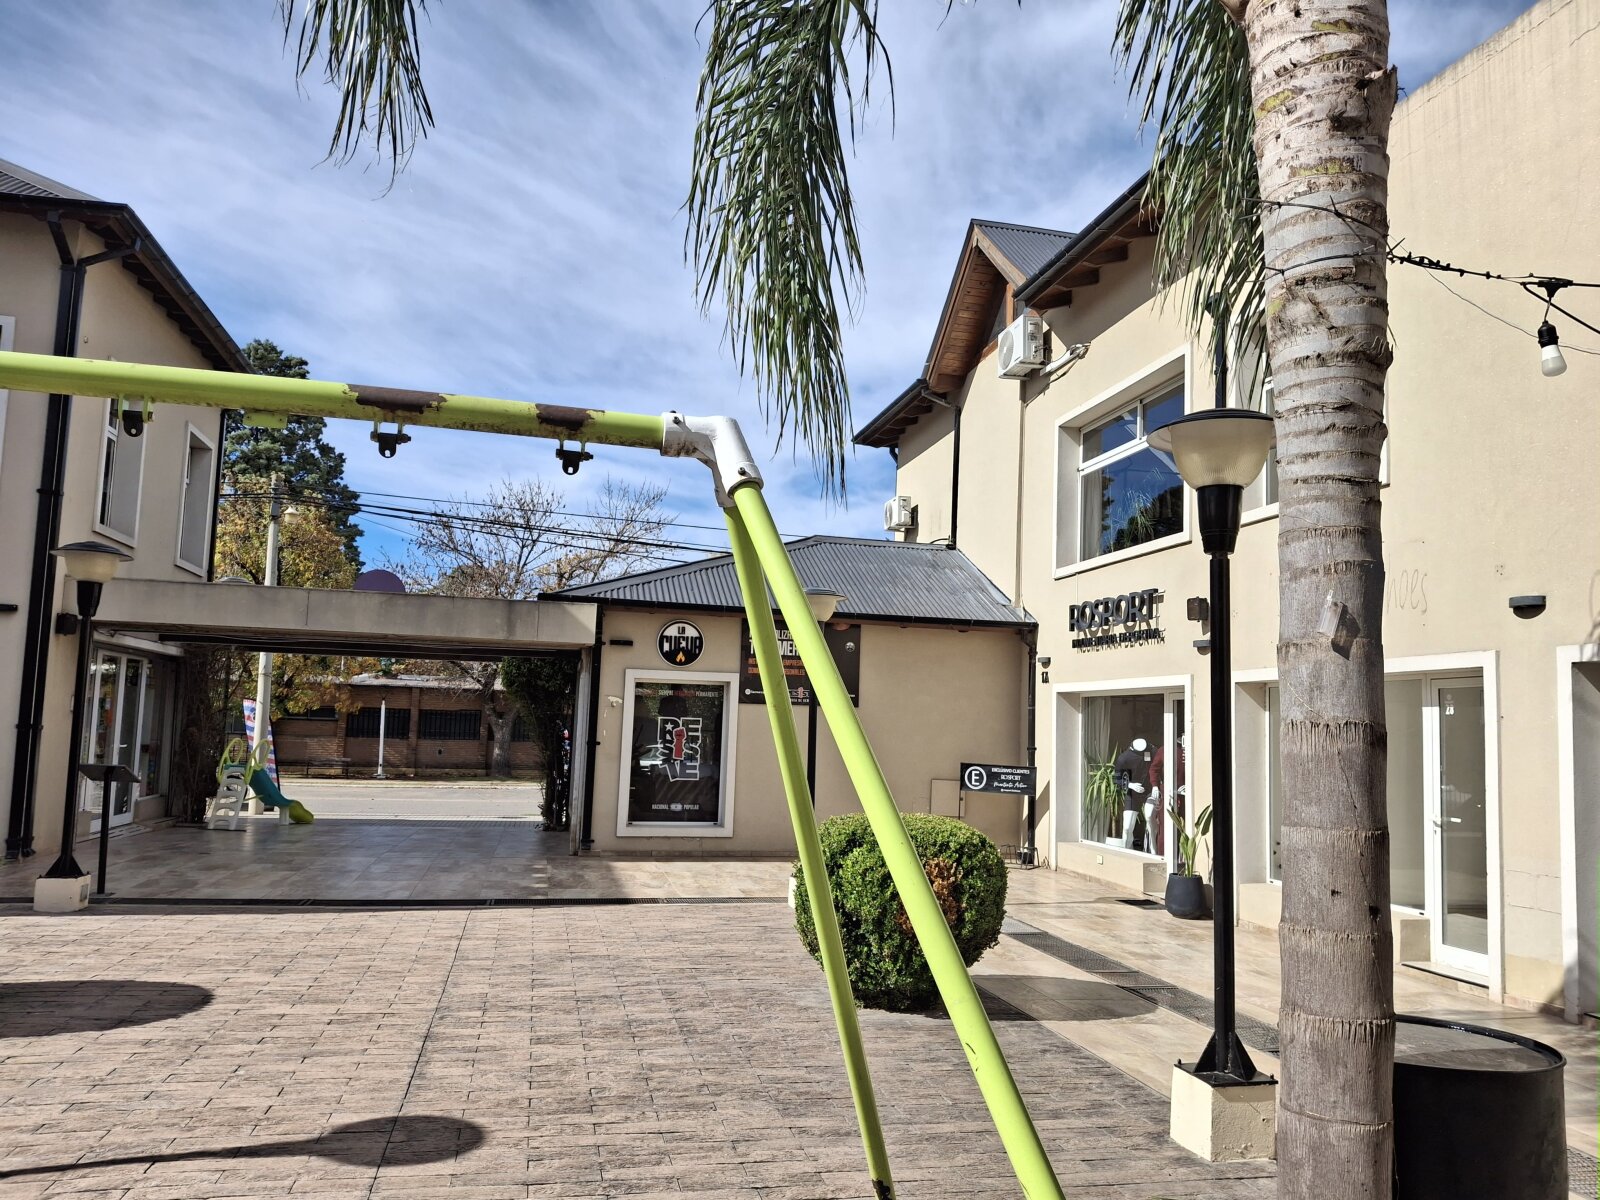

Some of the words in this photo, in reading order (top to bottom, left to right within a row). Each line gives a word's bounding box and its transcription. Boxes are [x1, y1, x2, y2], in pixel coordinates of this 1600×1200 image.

[1069, 588, 1158, 632] ROSPORT
[677, 626, 685, 635] LA
[662, 636, 701, 654] CUEVA
